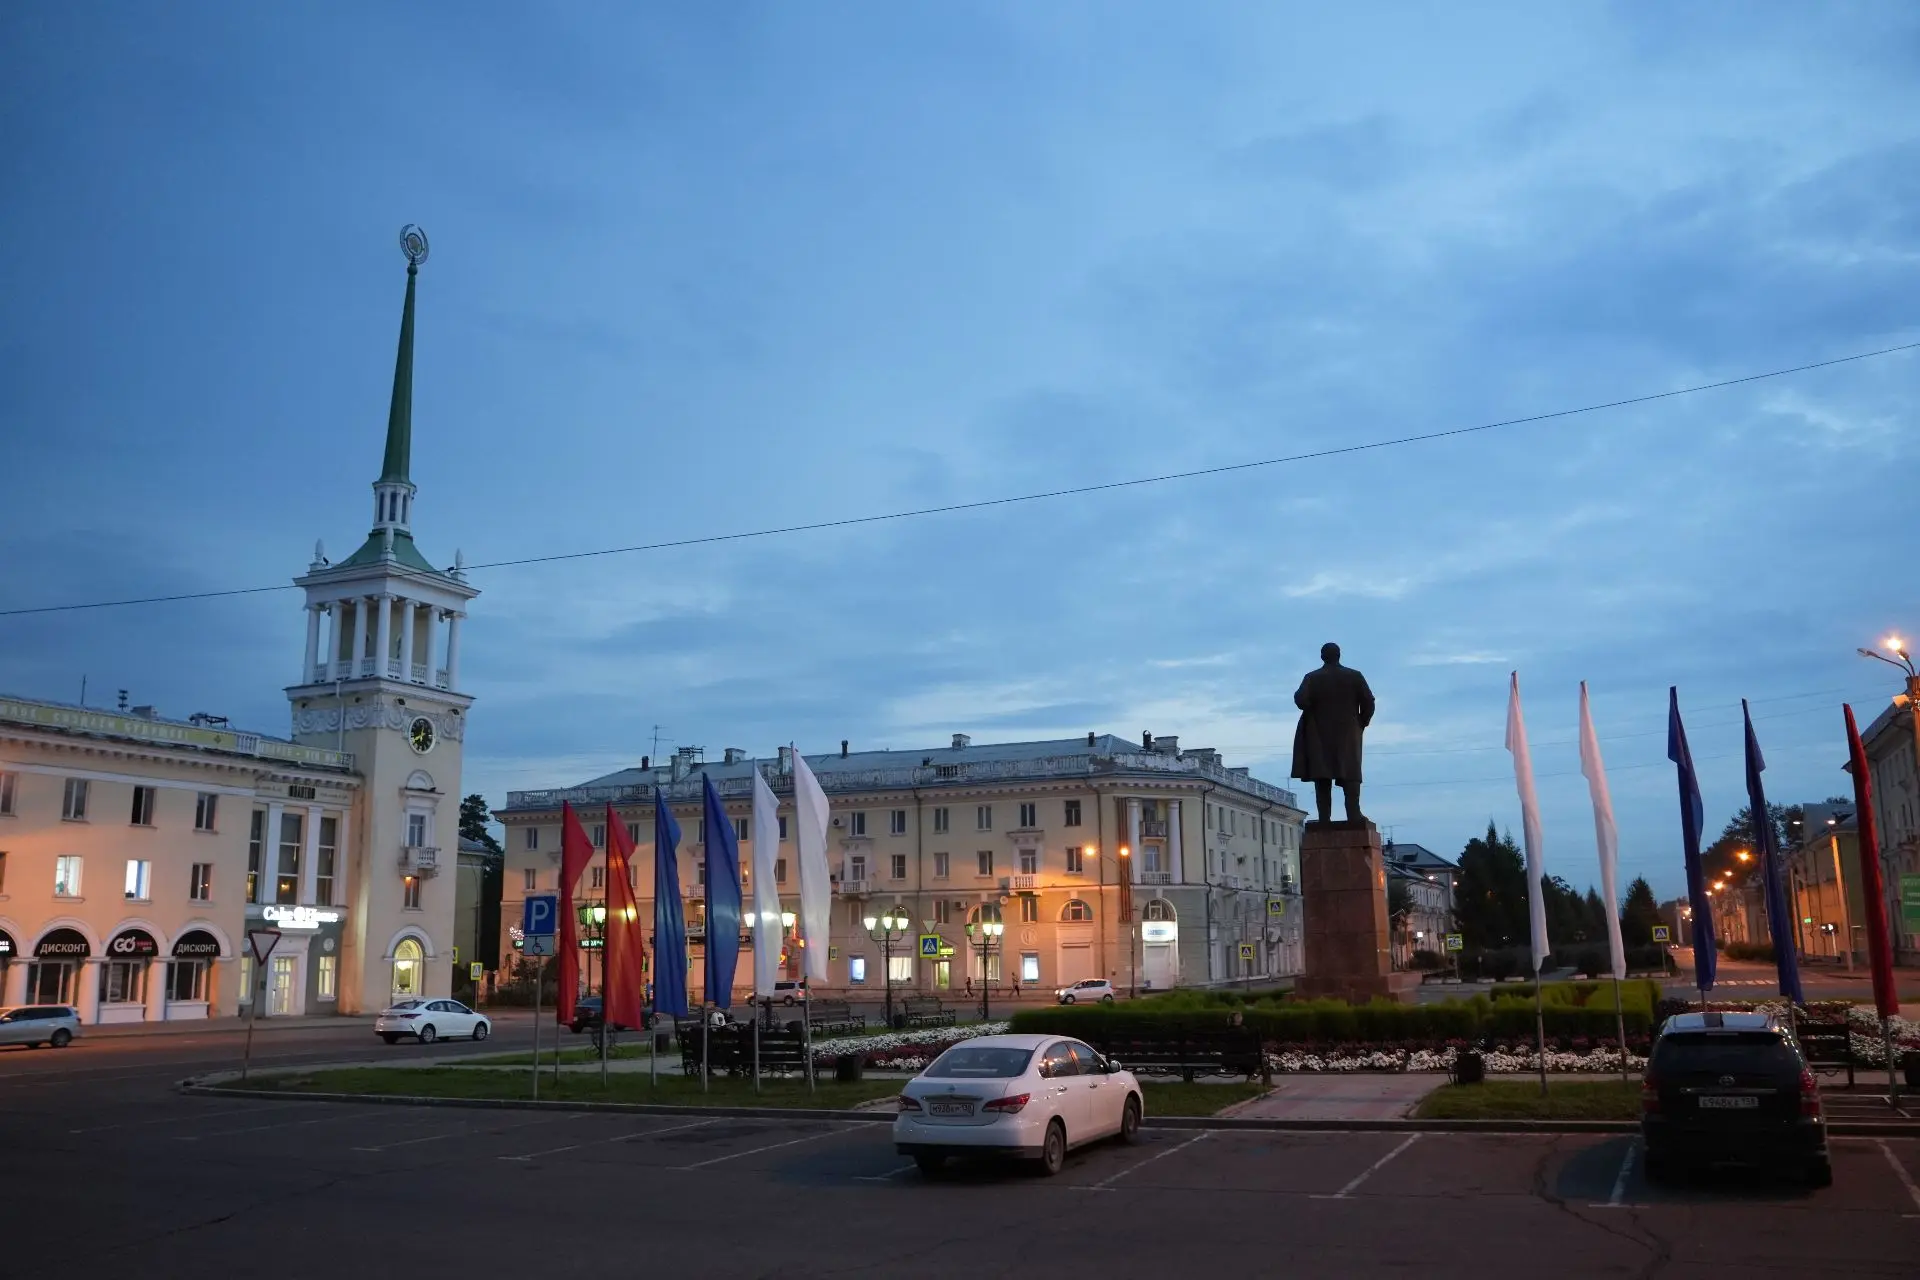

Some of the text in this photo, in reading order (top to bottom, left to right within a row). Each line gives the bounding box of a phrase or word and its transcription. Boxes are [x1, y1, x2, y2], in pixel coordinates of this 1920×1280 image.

[531, 900, 549, 930] P
[40, 943, 87, 955] ДИСКОНТ
[176, 943, 216, 954] ДИСКОНТ
